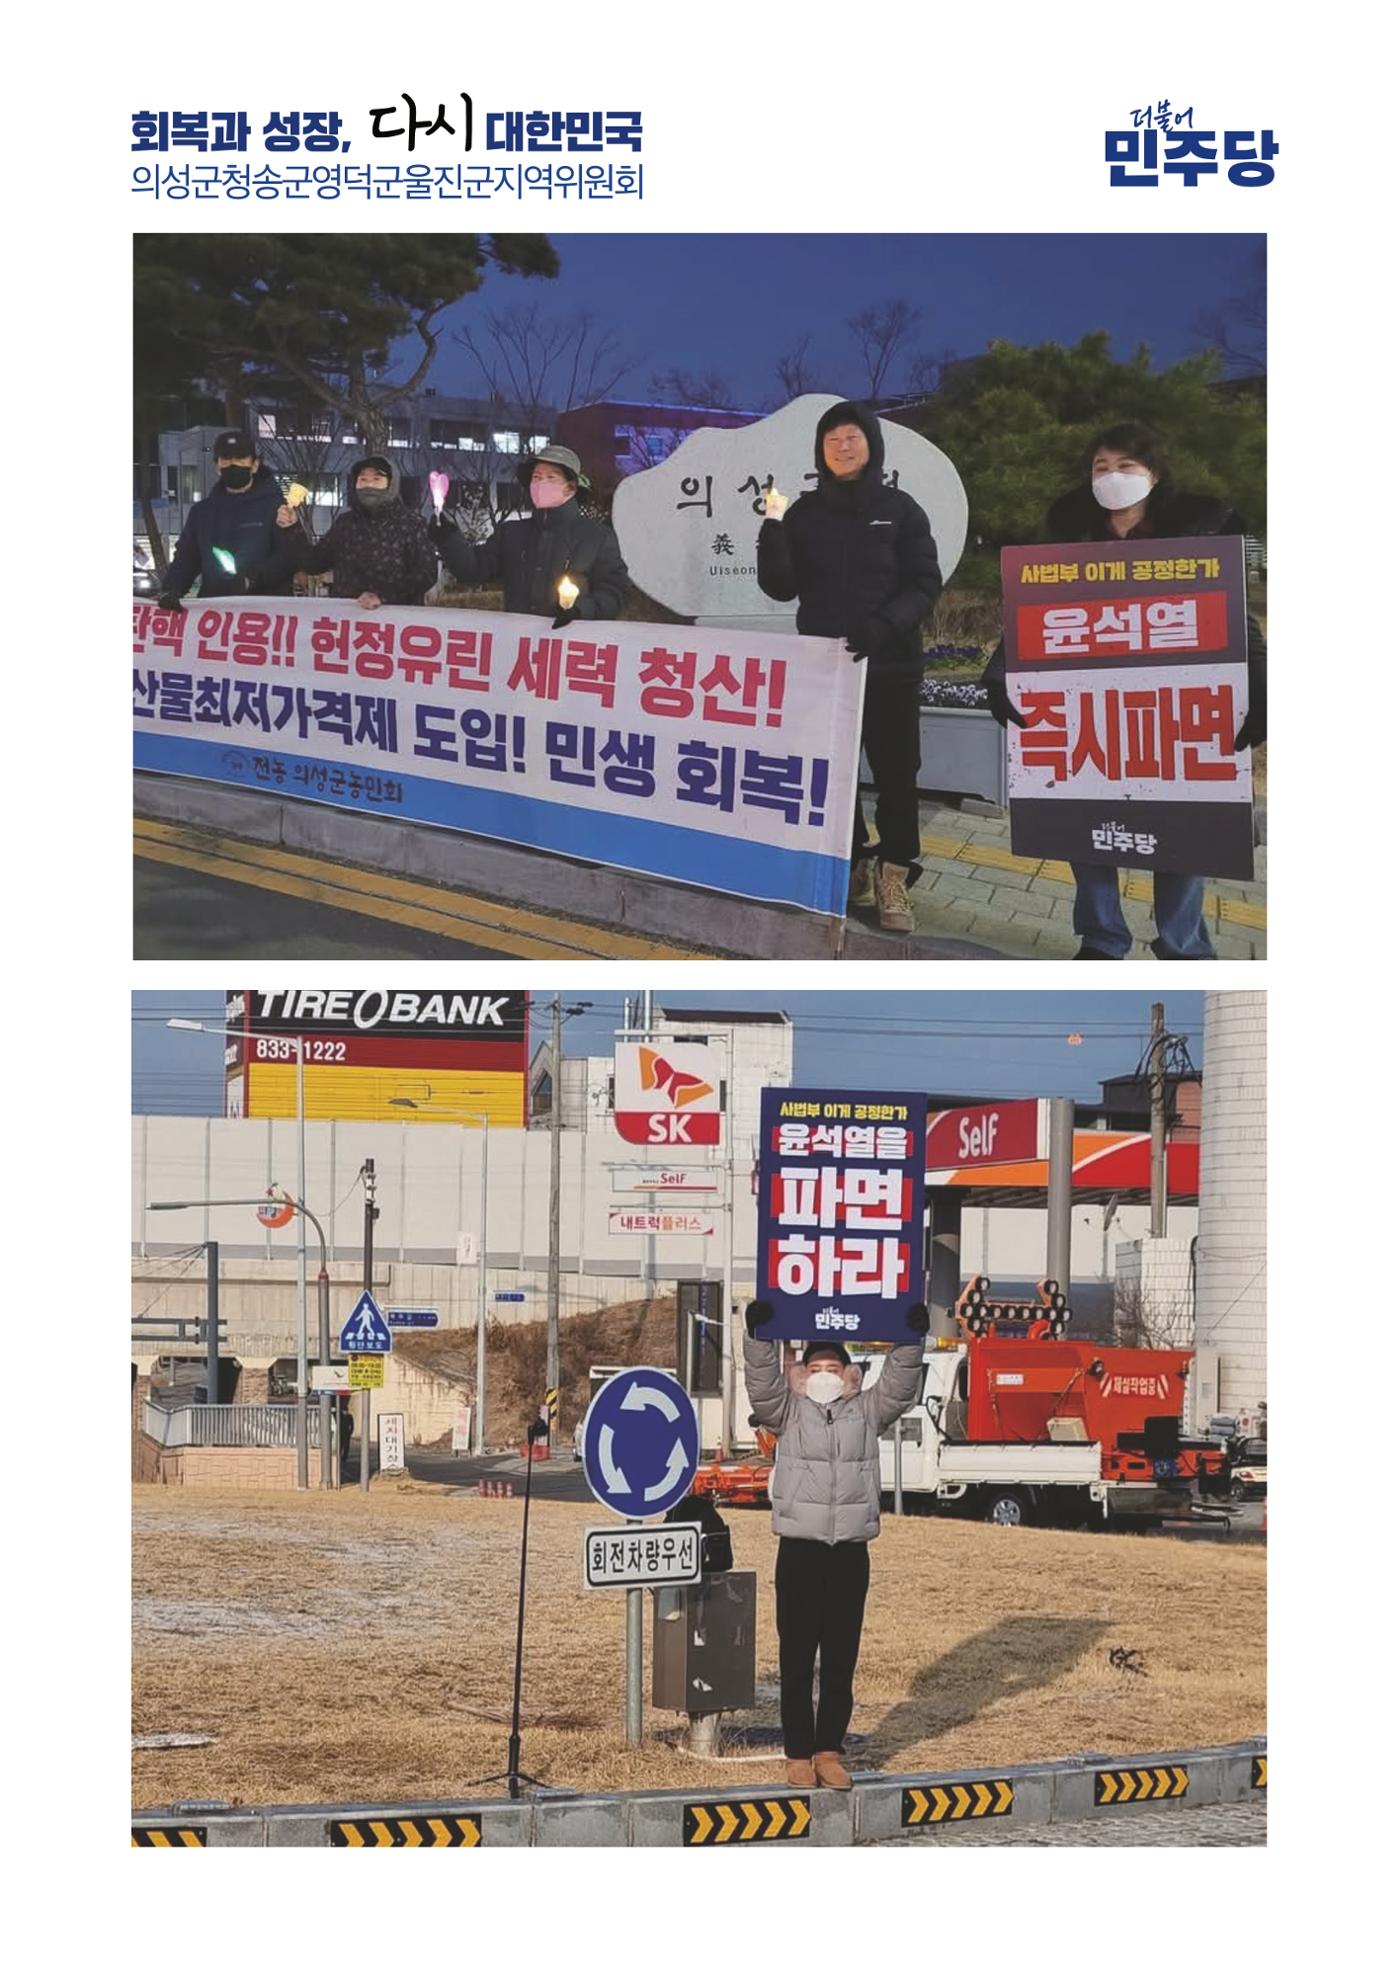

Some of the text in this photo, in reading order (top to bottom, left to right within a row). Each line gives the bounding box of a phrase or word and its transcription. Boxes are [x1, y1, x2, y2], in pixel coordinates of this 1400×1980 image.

[1020, 557, 1221, 584] 사법부 이게 공정한가
[1042, 599, 1199, 655] 윤석열
[196, 609, 298, 668] 인용!!
[310, 615, 494, 692] 헌정유린
[506, 636, 619, 709] 세력
[638, 647, 787, 728] 청산!
[1019, 684, 1238, 782] 즉시파면
[412, 703, 526, 774] 도입!
[545, 720, 656, 798] 민생
[676, 739, 829, 827] 회복!
[1092, 829, 1158, 855] 민주당
[647, 1114, 693, 1144] SK
[779, 1101, 908, 1121] 사법부 이게 공정한가
[778, 1122, 908, 1160] 윤석열을
[958, 1112, 999, 1160] Self
[778, 1166, 903, 1231] 파면
[620, 1215, 702, 1232] 내트럭플러스
[777, 1233, 905, 1299] 하라
[815, 1313, 861, 1330] 민주당
[592, 1536, 693, 1574] 회전차량우선
